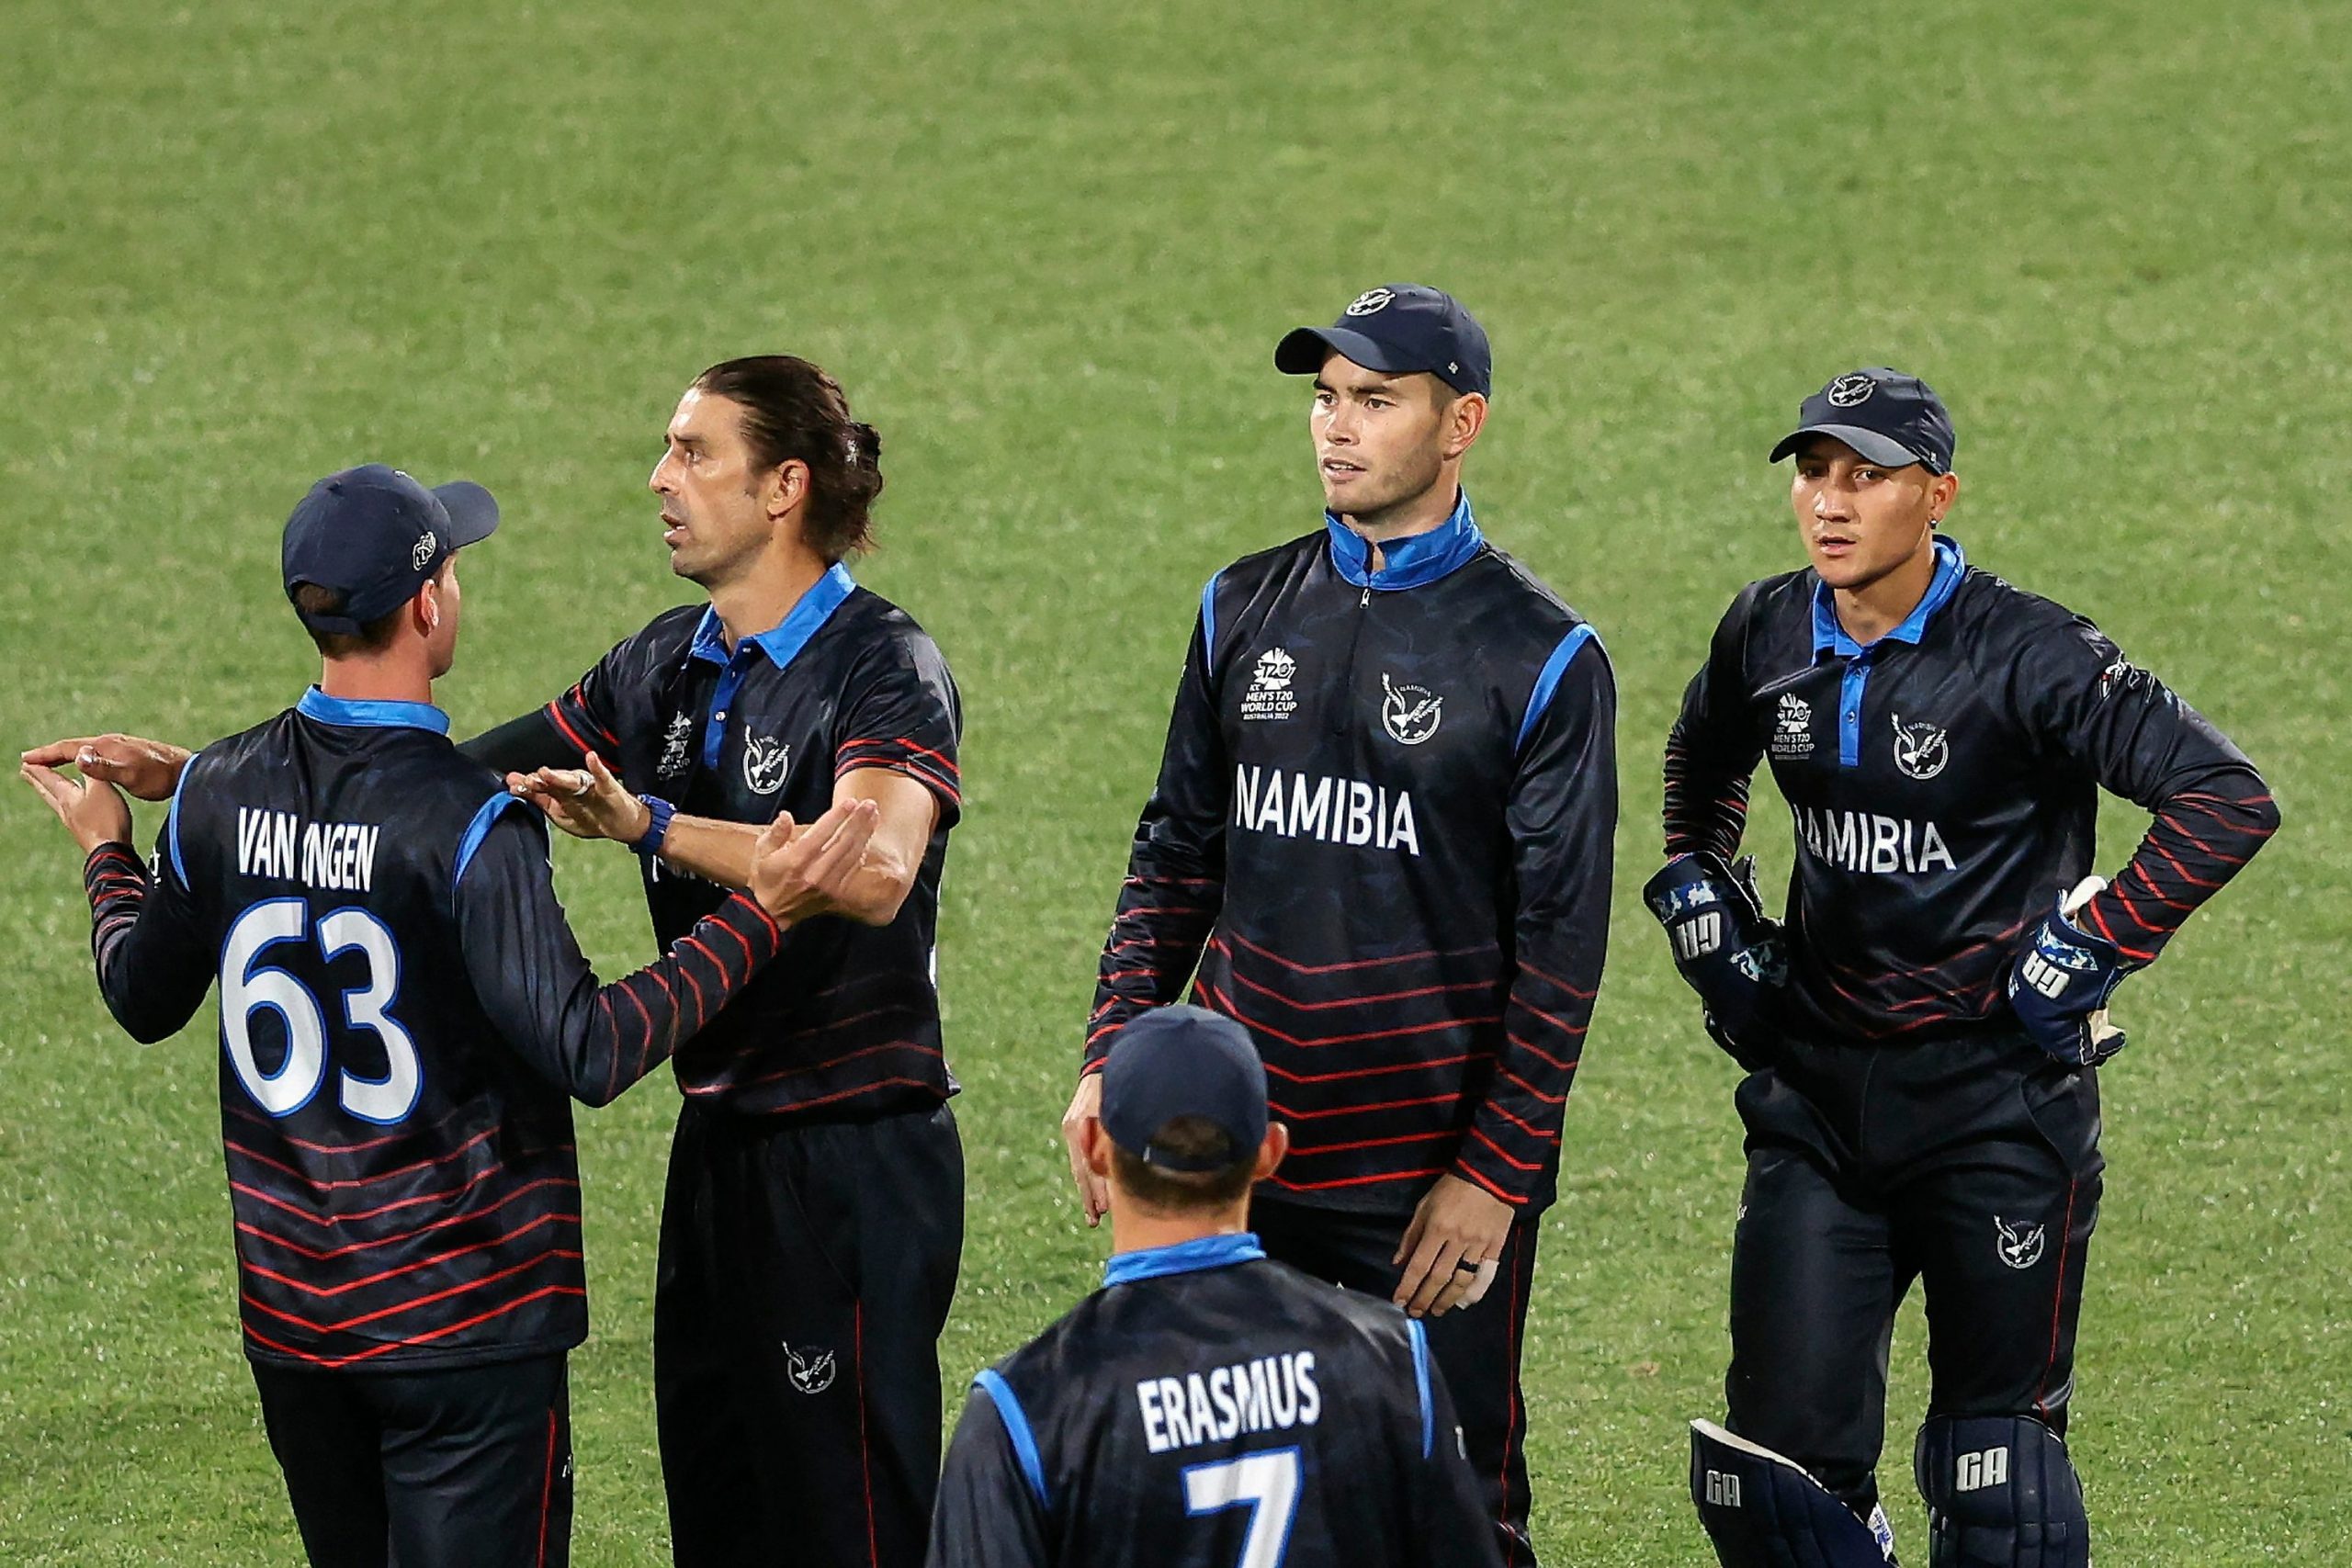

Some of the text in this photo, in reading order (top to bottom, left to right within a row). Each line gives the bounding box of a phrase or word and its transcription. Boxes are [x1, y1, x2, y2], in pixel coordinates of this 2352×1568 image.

[1240, 701, 1297, 713] WORLD CUP
[1275, 691, 1294, 701] T20
[1797, 743, 1815, 753] CUP
[1236, 763, 1420, 857] NAMIBIA
[238, 806, 299, 881] VAN
[220, 897, 424, 1126] 63
[1136, 1350, 1320, 1453] ERASMUS
[1706, 1469, 1741, 1507] GA
[1956, 1446, 2007, 1492] GA
[1180, 1444, 1306, 1568] 7
